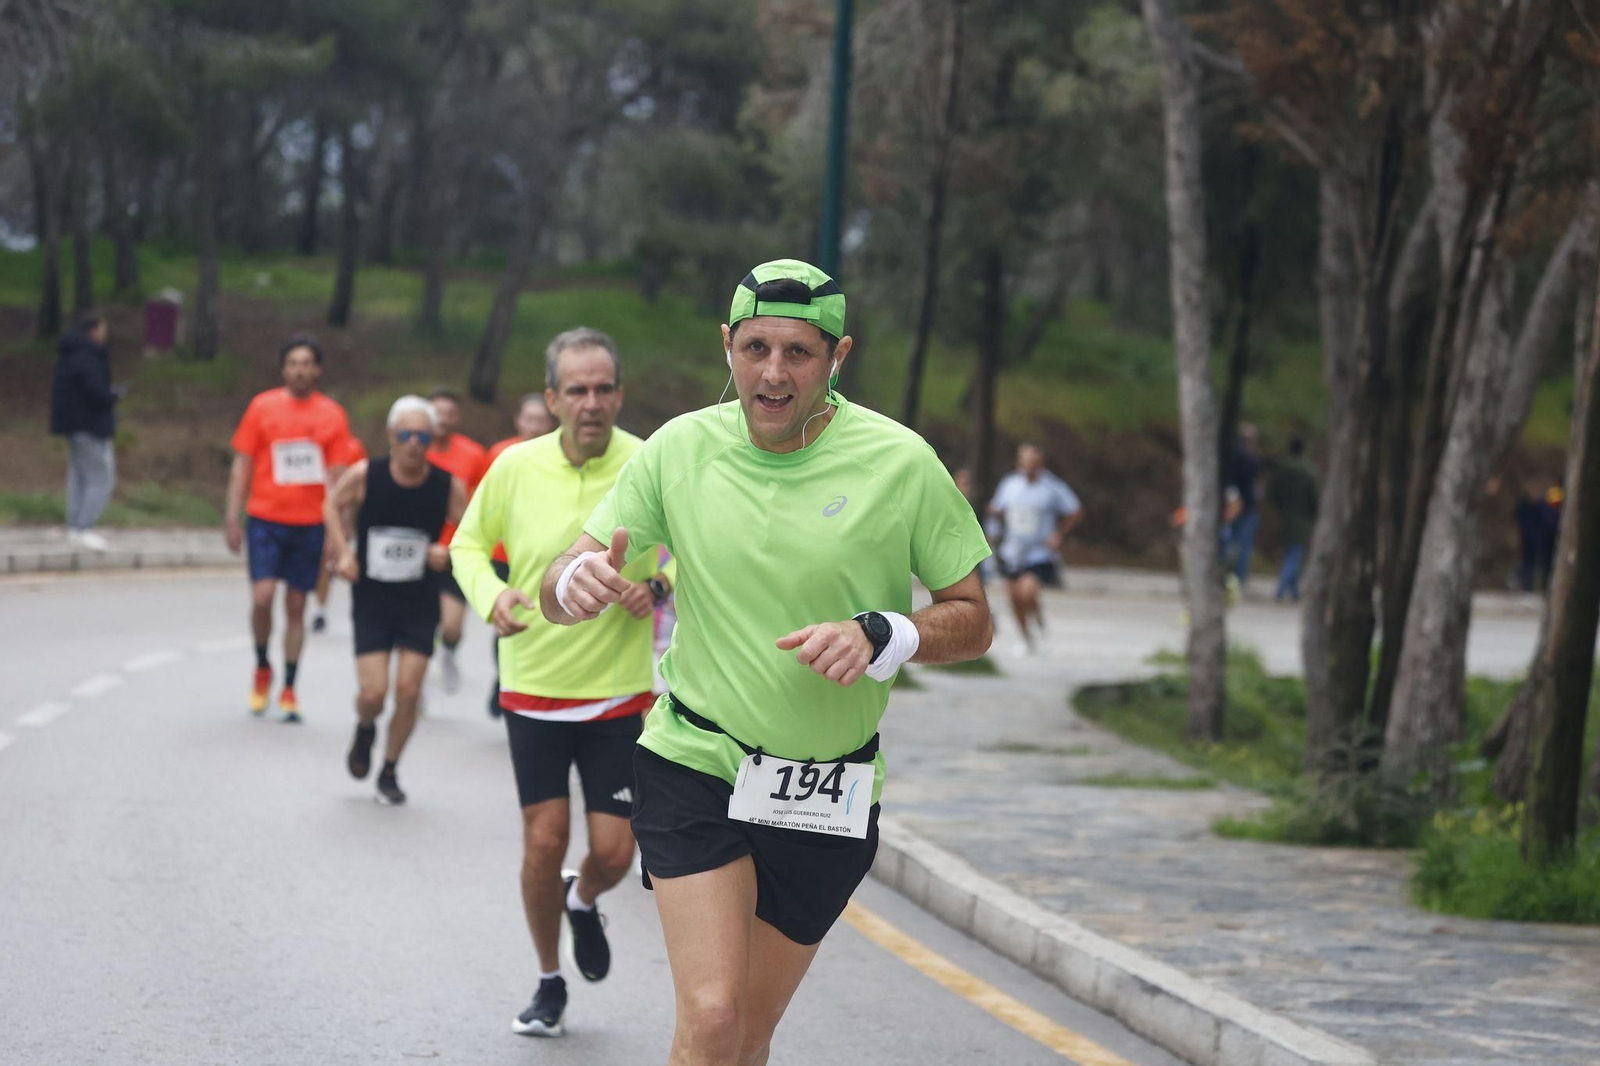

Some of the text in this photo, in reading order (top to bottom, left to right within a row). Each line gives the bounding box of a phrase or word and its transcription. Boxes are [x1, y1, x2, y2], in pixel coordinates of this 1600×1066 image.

[770, 765, 843, 803] 194
[793, 810, 820, 818] GUERRERO
[771, 820, 801, 829] MARATÓN
[801, 822, 818, 830] PEÑA
[827, 825, 851, 833] BASTÓN
